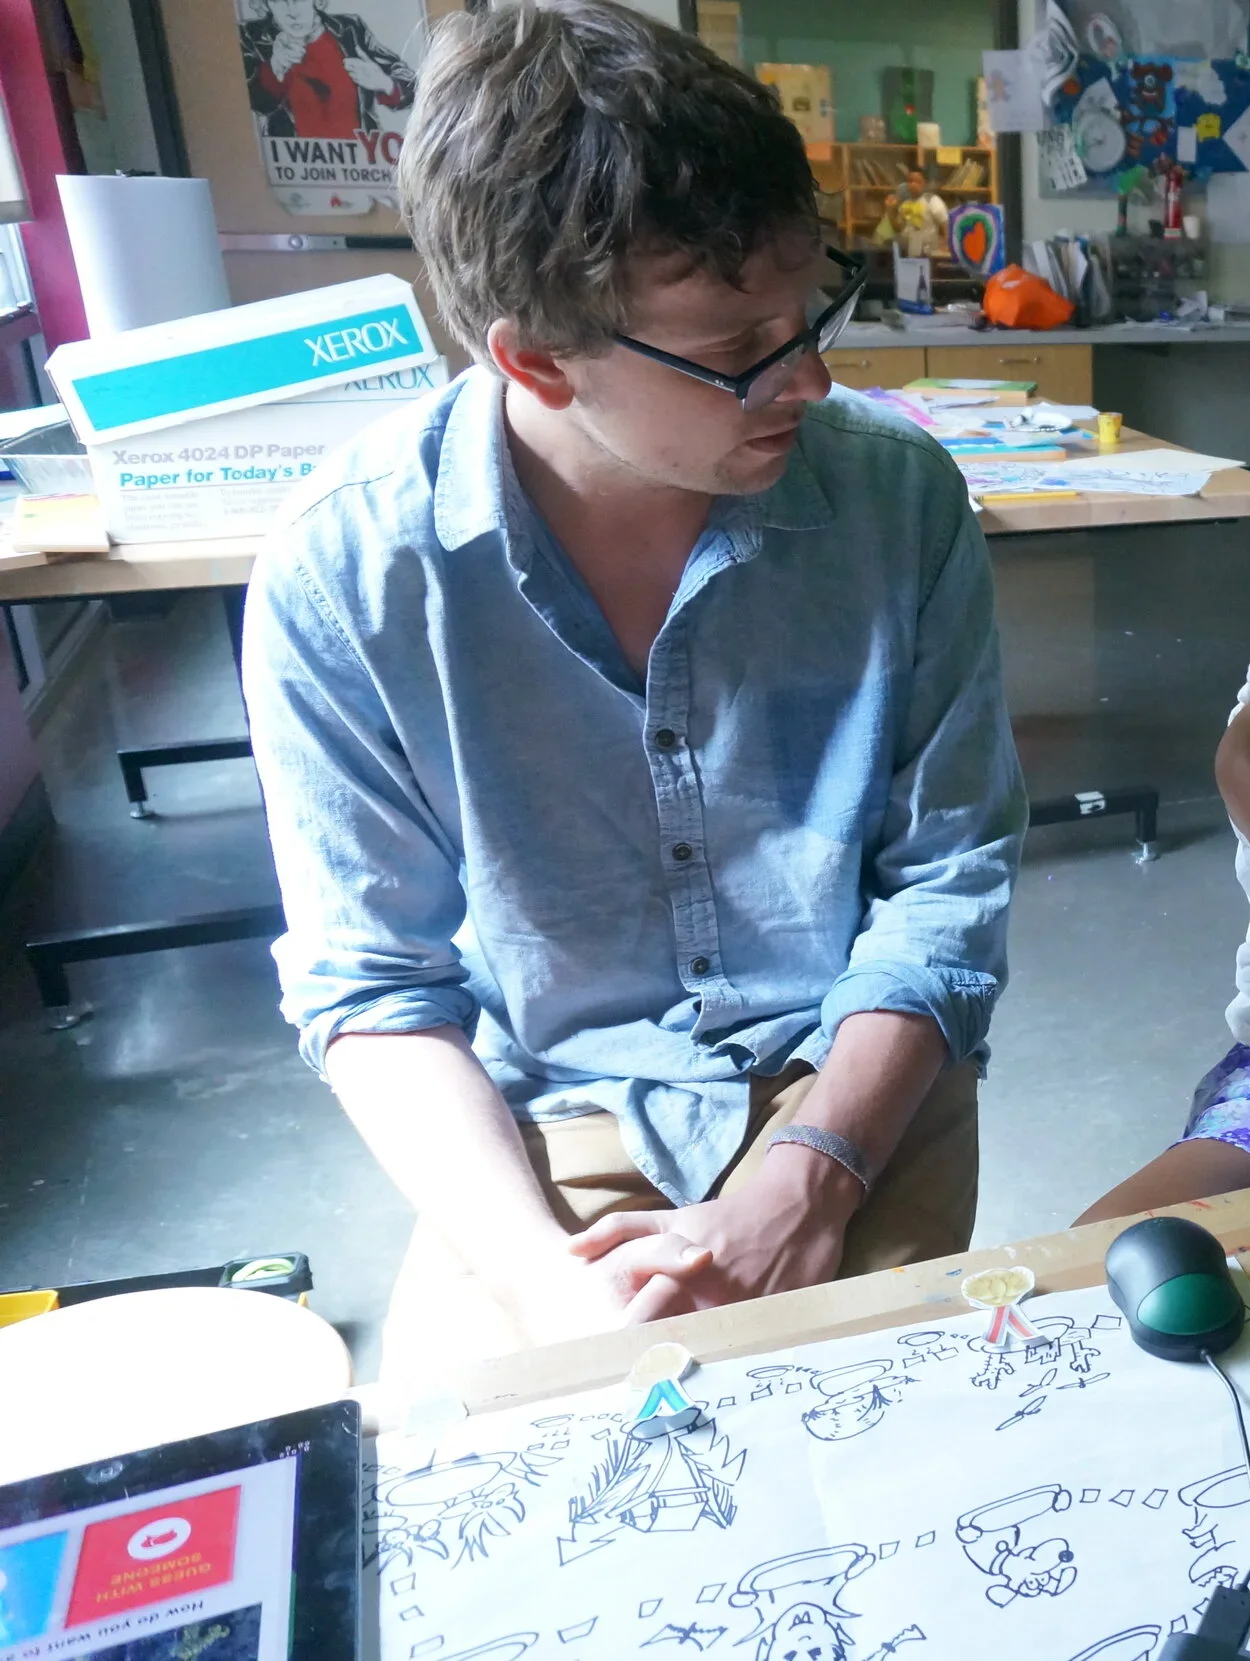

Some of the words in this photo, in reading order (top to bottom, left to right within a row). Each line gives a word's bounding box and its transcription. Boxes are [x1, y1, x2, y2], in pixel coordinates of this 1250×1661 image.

[270, 139, 280, 163] I
[284, 140, 358, 165] WANT
[275, 166, 296, 181] TO
[300, 167, 337, 181] JOIN
[341, 167, 392, 182] TORCH
[303, 317, 409, 367] XEROX
[112, 449, 175, 465] Xerox
[178, 446, 230, 462] 4024
[234, 444, 264, 459] DP
[267, 443, 326, 459] Paper
[120, 471, 180, 489] Paper
[186, 468, 214, 484] for
[220, 463, 294, 482] Today's
[111, 1552, 202, 1586] SOMEONE
[149, 1562, 212, 1589] GUESS
[96, 1581, 143, 1603] WITH
[137, 1611, 160, 1625] do
[166, 1600, 205, 1619] How
[98, 1618, 132, 1637] you
[47, 1633, 91, 1652] want
